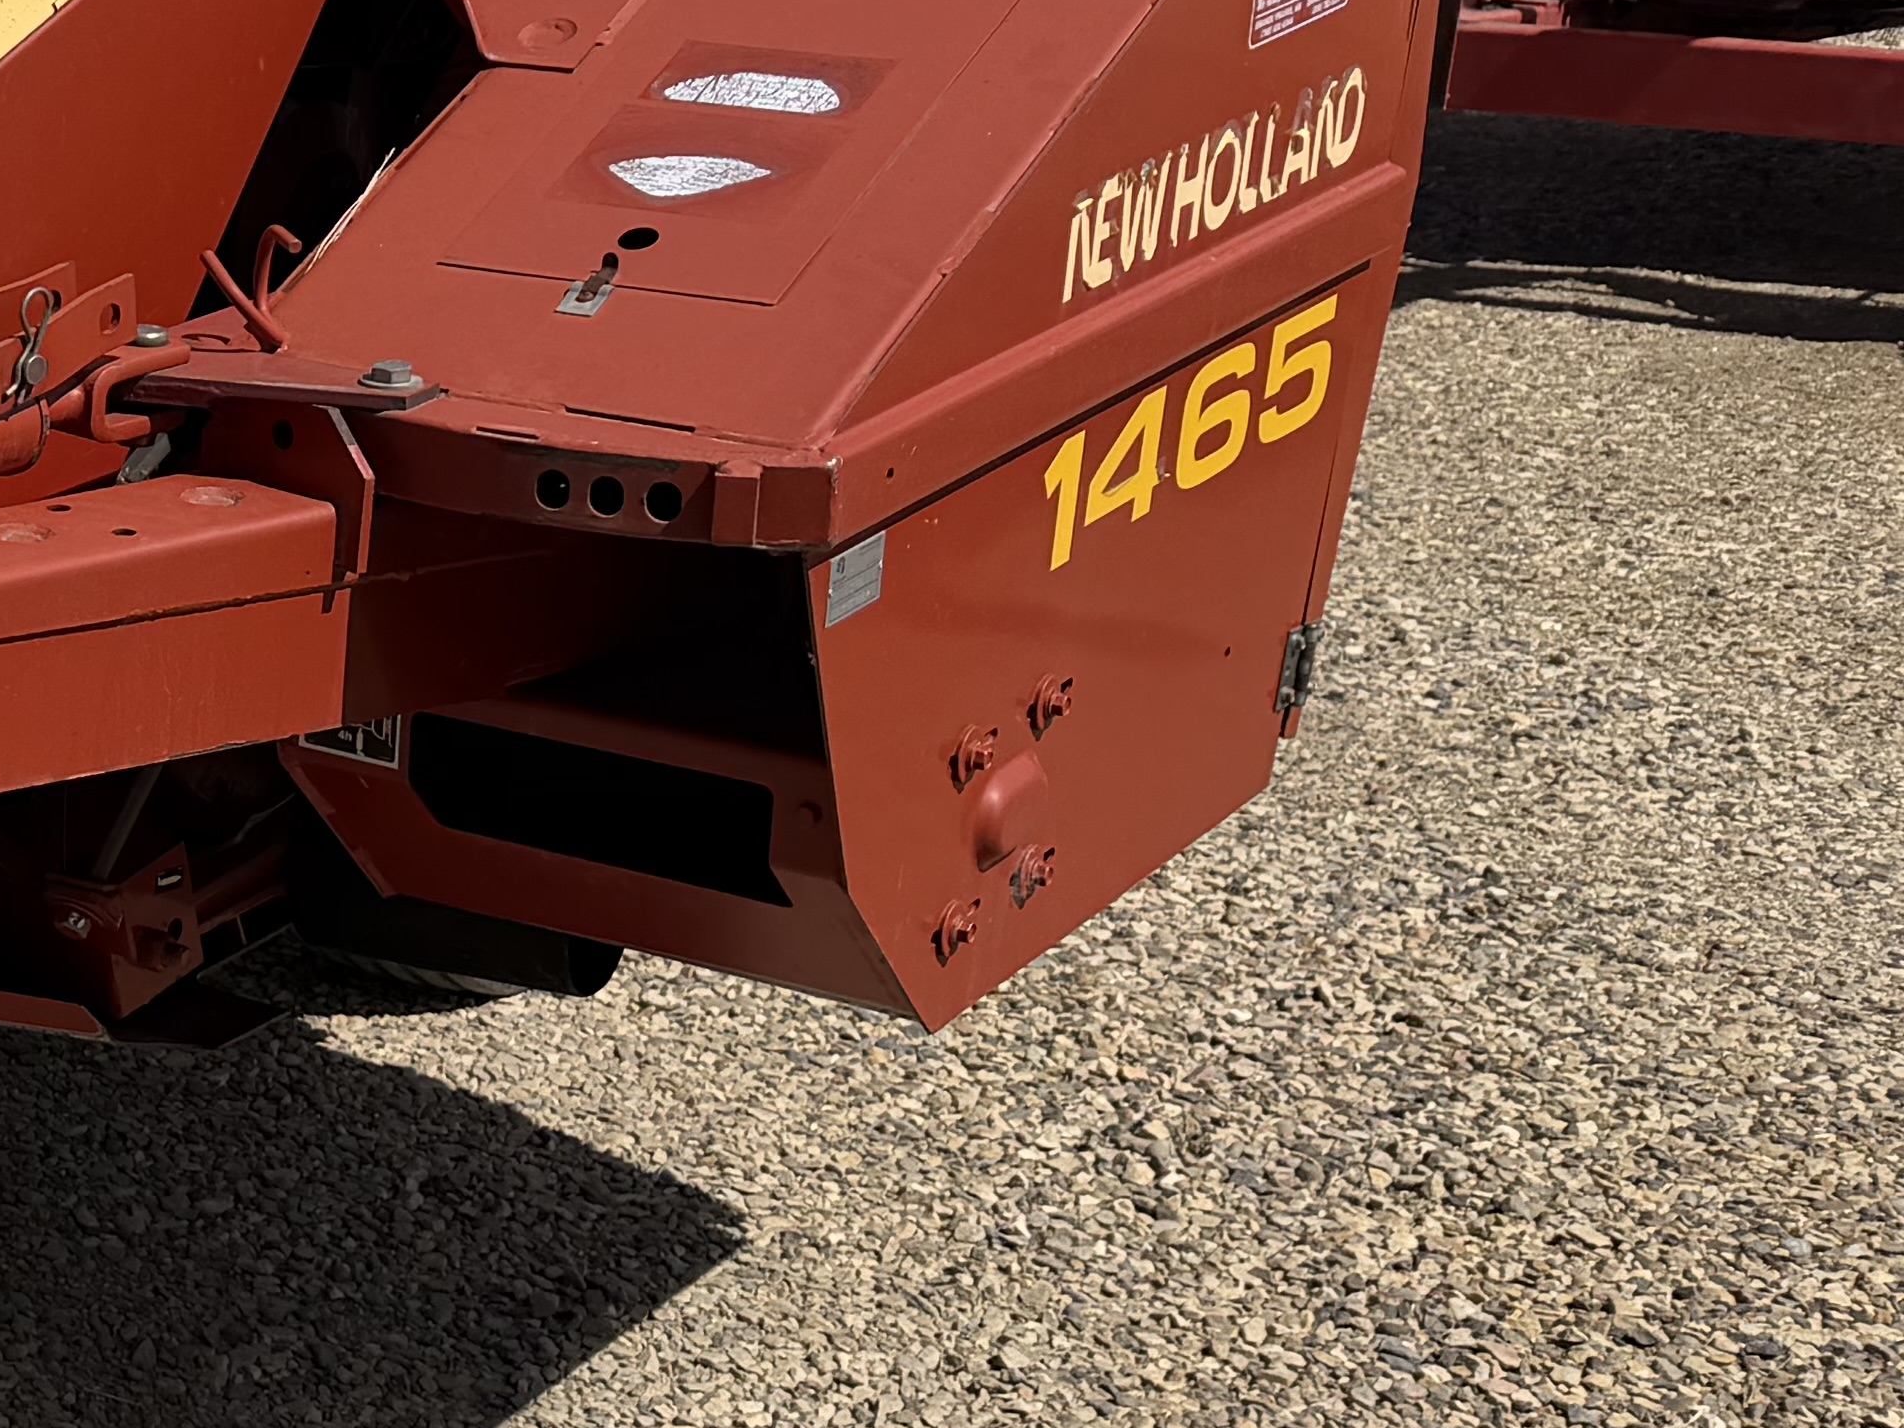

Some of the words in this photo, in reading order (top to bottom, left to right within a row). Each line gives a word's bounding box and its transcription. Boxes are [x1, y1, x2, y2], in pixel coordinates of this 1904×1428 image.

[1062, 150, 1172, 304] NEW
[1170, 66, 1367, 248] HOLLAND
[1044, 293, 1338, 572] 1465
